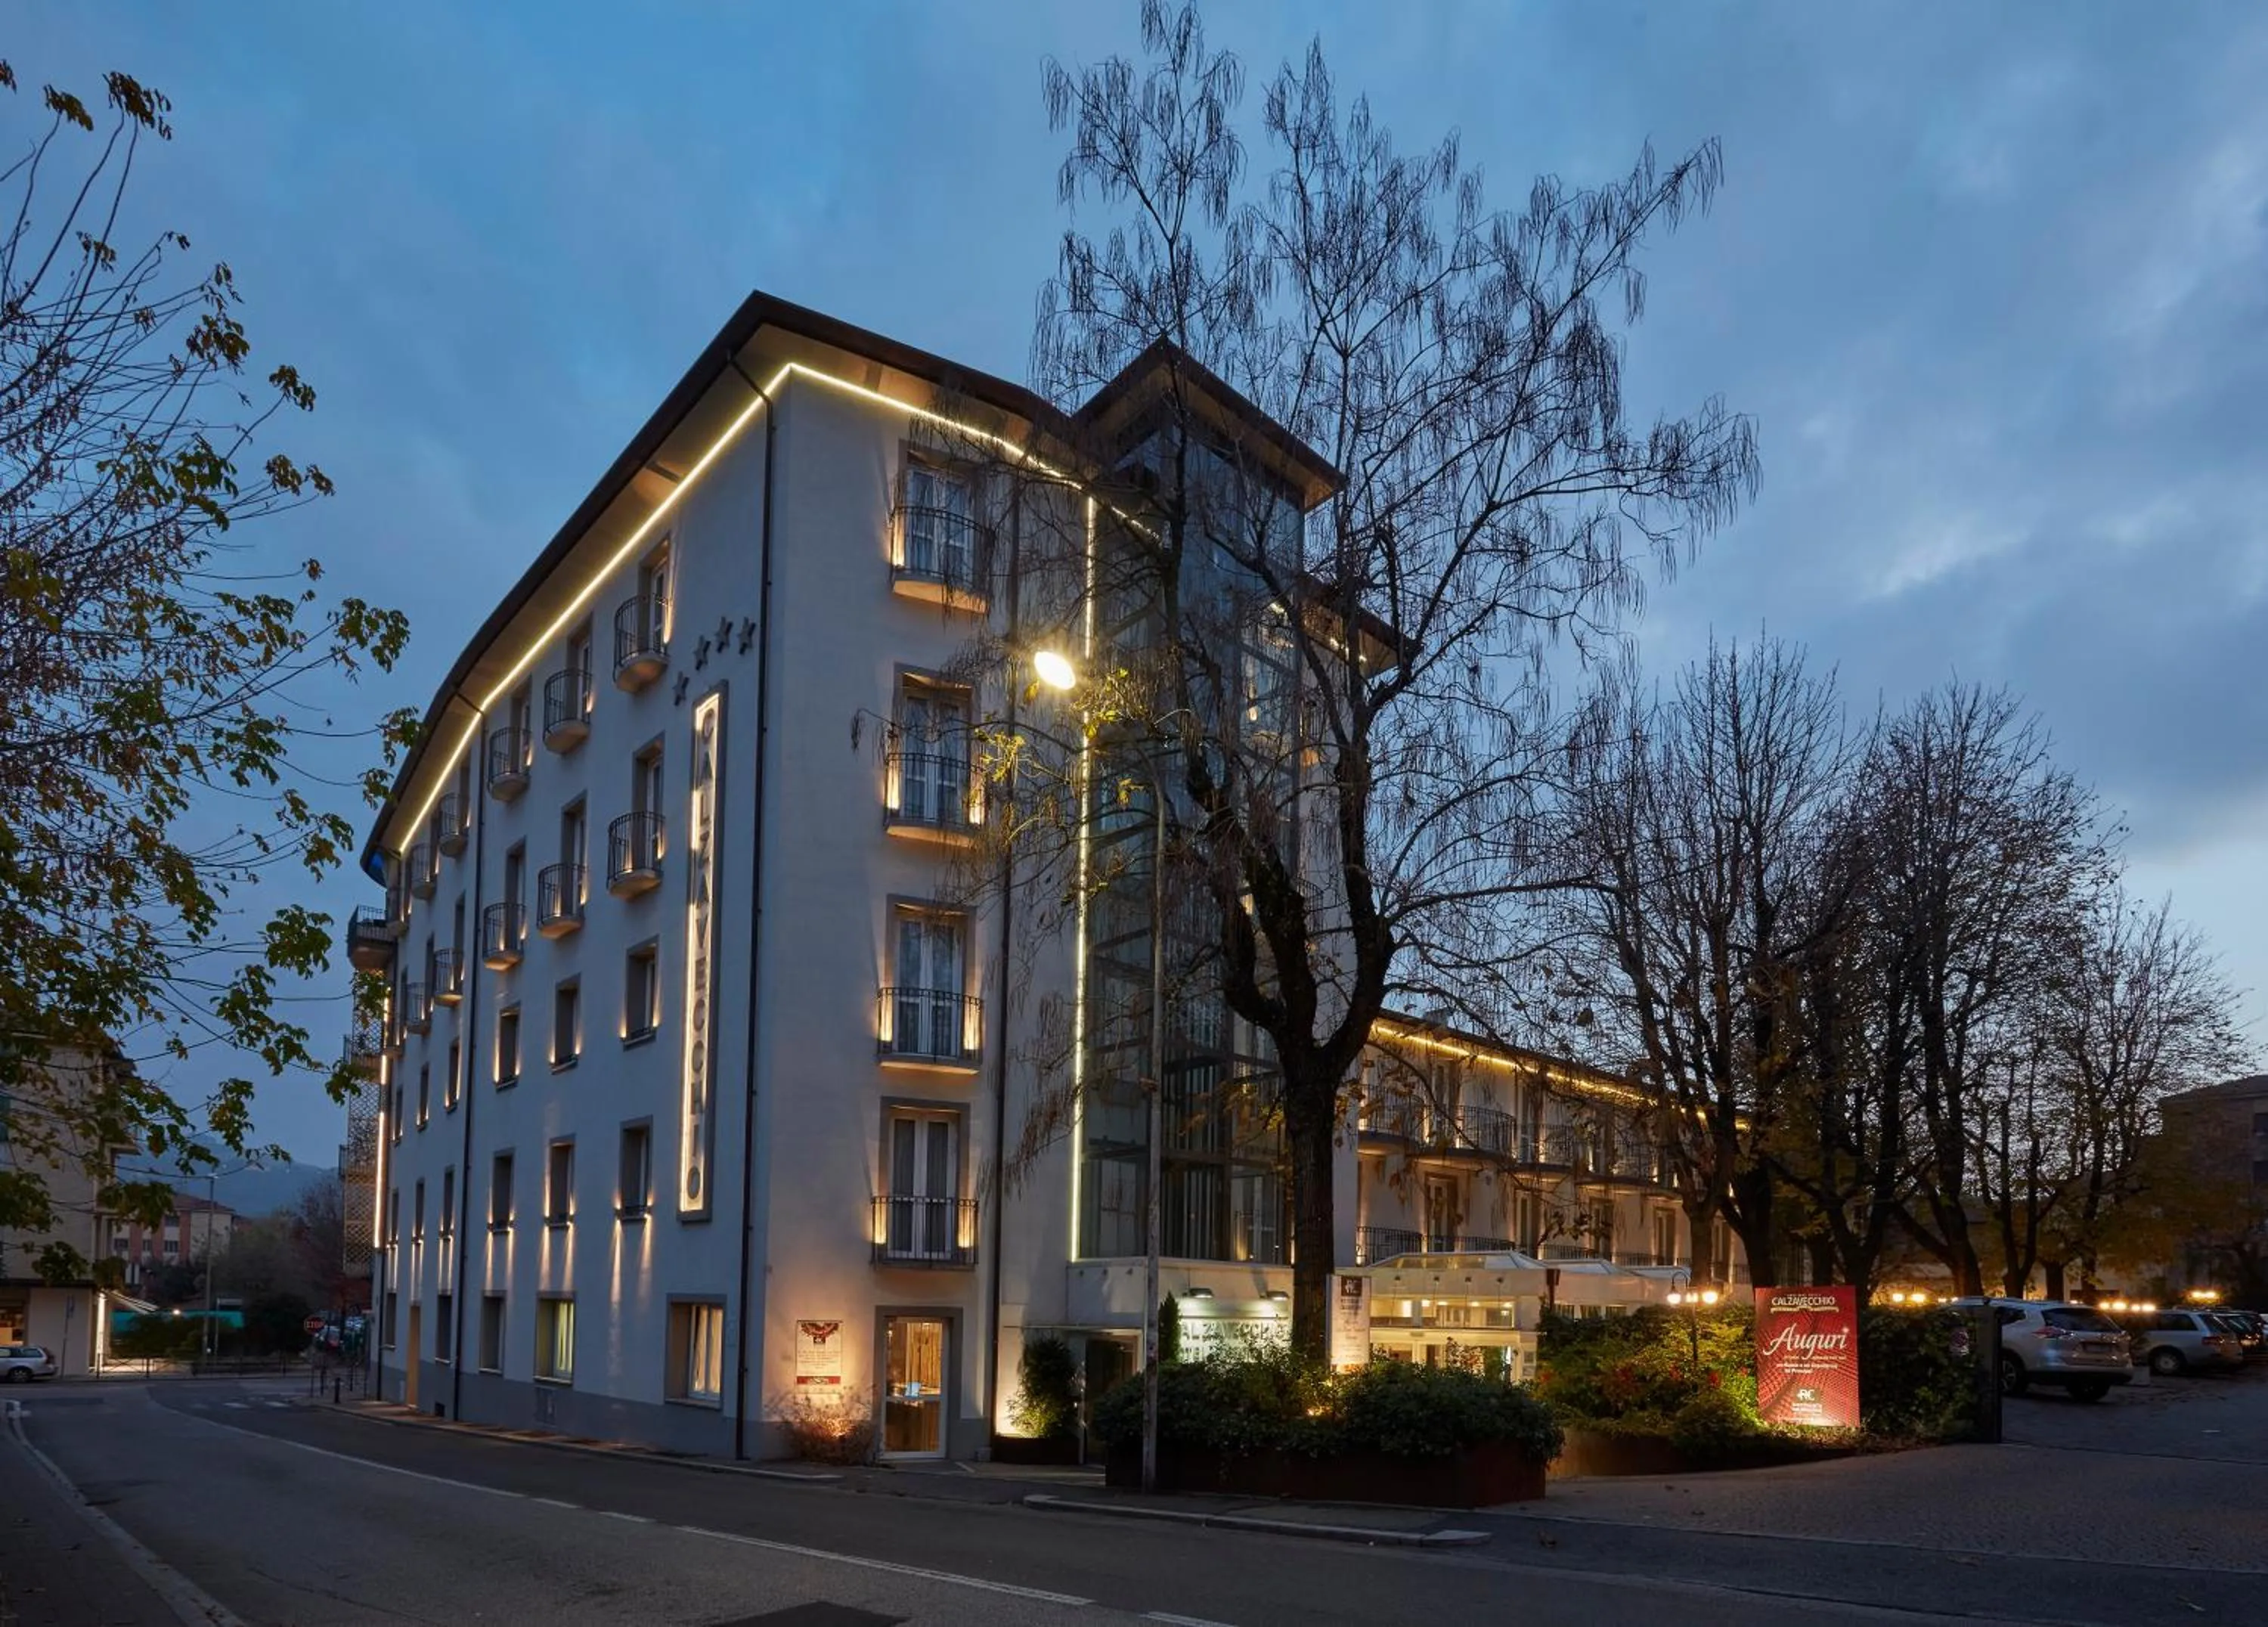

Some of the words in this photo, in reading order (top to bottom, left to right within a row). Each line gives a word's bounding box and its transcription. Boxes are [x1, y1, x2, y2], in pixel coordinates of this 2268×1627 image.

[686, 708, 714, 1200] CALZAVECCHIO
[1771, 1296, 1836, 1306] CALZAVECCHIO
[1763, 1323, 1848, 1359] Auguri
